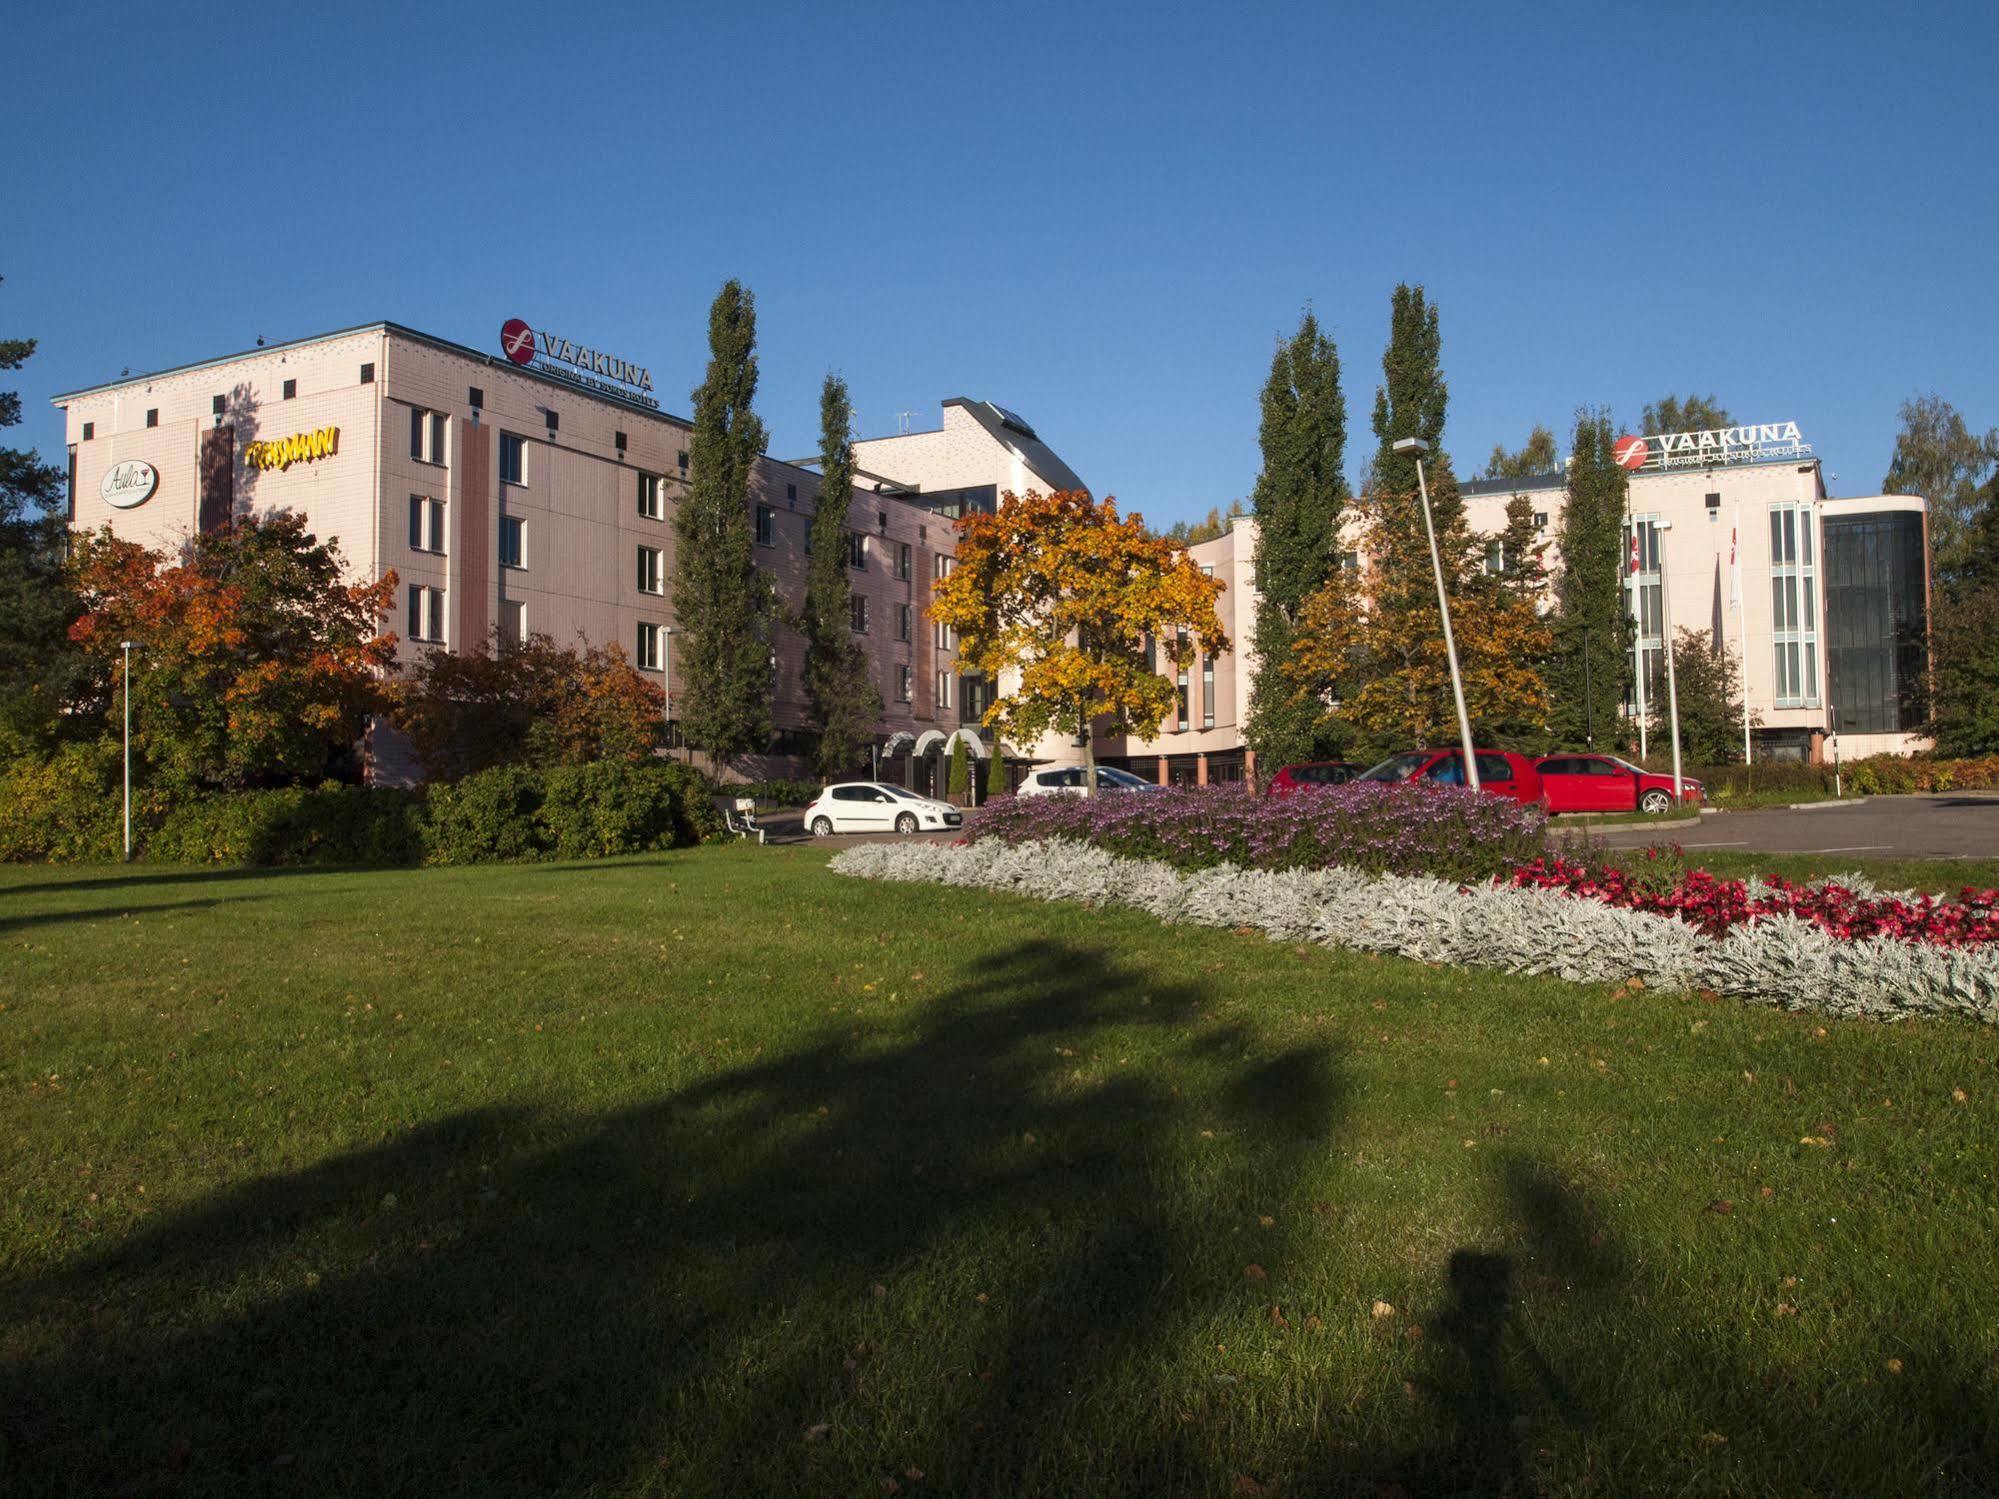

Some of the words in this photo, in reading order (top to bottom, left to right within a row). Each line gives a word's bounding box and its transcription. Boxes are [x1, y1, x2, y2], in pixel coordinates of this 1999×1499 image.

[541, 361, 585, 383] ORIGINA
[542, 331, 654, 392] VAAKUNA
[1659, 421, 1802, 451] VAAKUNA
[105, 464, 144, 492] Aula
